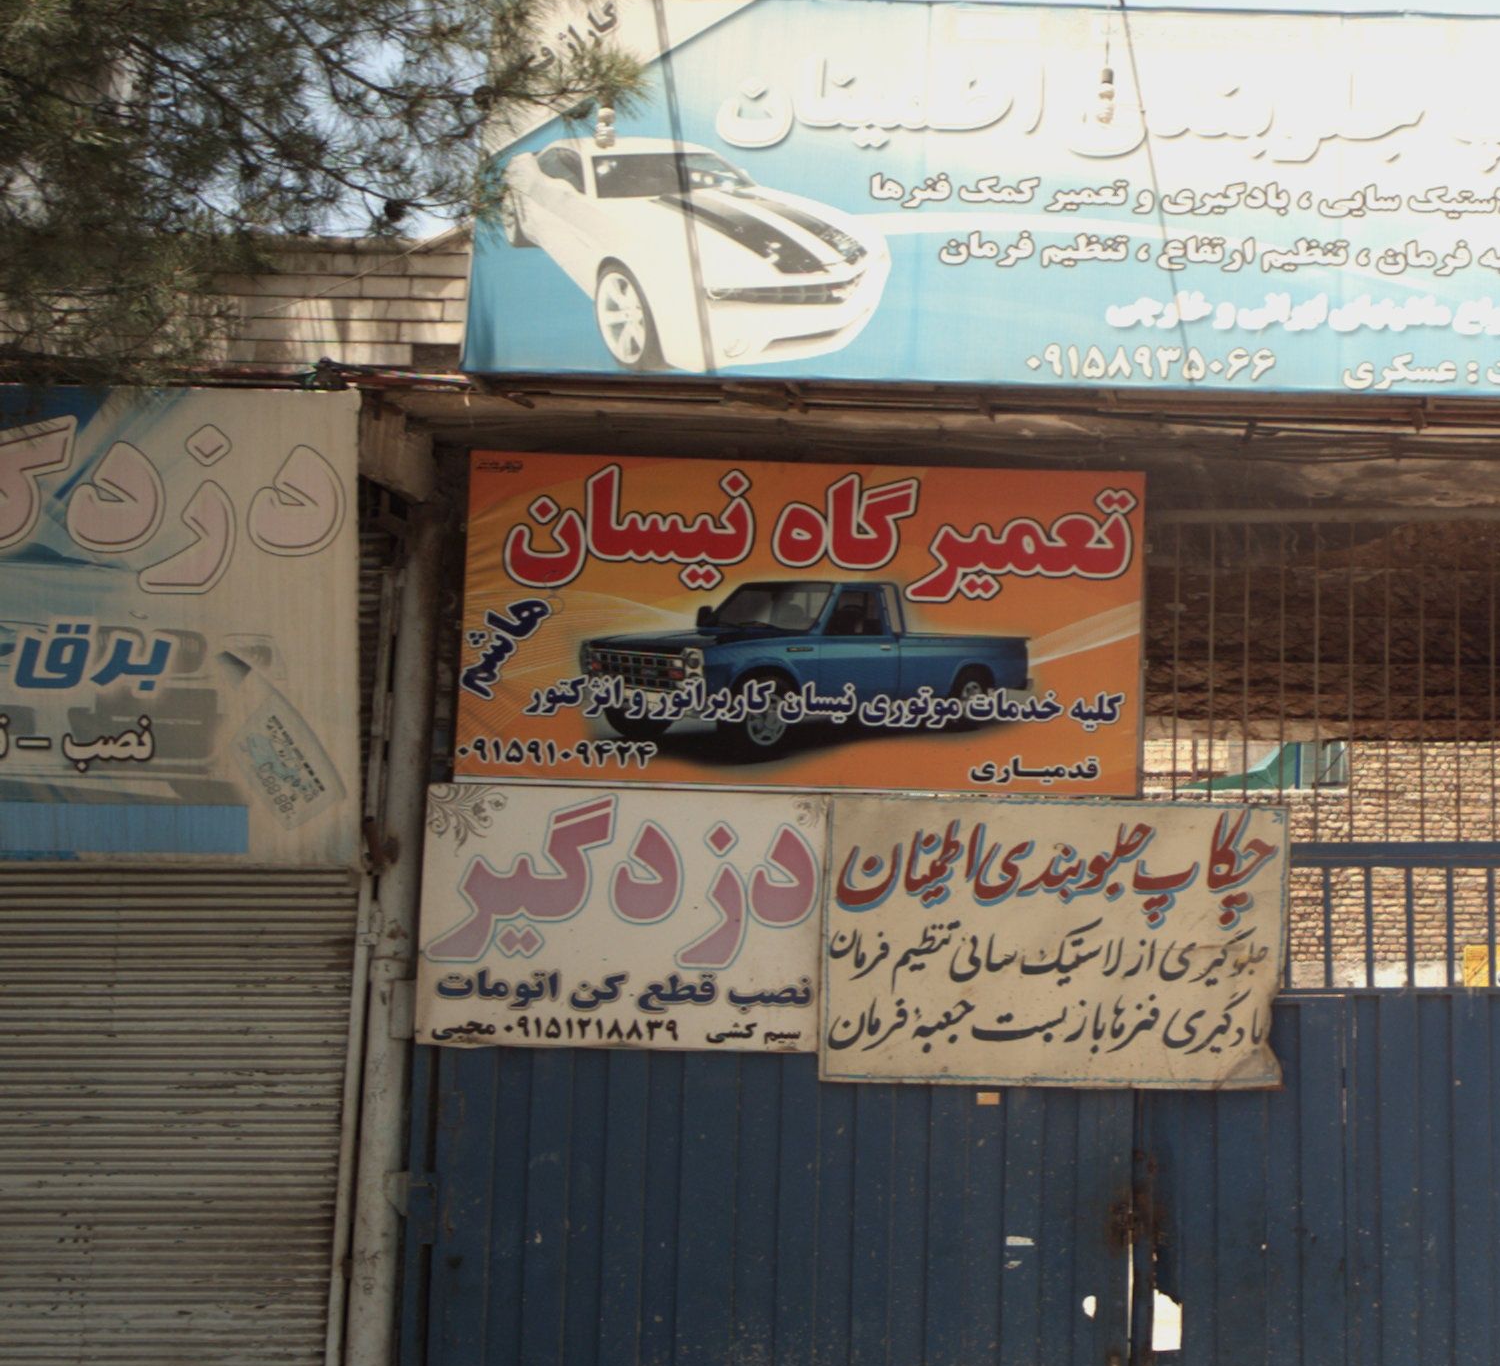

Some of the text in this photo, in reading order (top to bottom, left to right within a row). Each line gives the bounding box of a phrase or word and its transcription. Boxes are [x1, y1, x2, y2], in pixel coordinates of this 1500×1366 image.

[716, 47, 1048, 150] اطمینان
[869, 173, 953, 209] فنرها
[958, 176, 1041, 204] کمک
[1044, 180, 1130, 213] تعمیر
[1133, 189, 1155, 214] و
[1162, 182, 1290, 216] بادگیری
[938, 230, 1035, 267] فرمان
[1041, 233, 1130, 269] تنظیم
[1157, 236, 1256, 272] ارتفاع
[1261, 237, 1350, 273] تنظیم
[1376, 240, 1473, 277] فرمان
[1341, 352, 1458, 391] عسکری
[503, 463, 757, 588] نیسان
[14, 623, 172, 692] برق
[460, 598, 552, 701] هاشم
[625, 690, 643, 720] و
[649, 677, 775, 722] کاربراتور
[777, 681, 857, 724] نیسان
[859, 686, 962, 728] موتوری
[966, 688, 1065, 722] خدمات
[1069, 691, 1126, 731] کلیه
[62, 715, 155, 773] نصب
[425, 793, 819, 970] دزدگیر
[836, 808, 1279, 931] چکاپ جلوبندی اطمینان
[828, 928, 891, 982] فرمان
[891, 919, 961, 995] تنظیم
[1020, 917, 1126, 987] لاستیک
[1123, 938, 1157, 979] از
[435, 969, 814, 1014] نصب قطع کن اتومات
[706, 1022, 758, 1044] کشی
[828, 996, 911, 1052] فرمان
